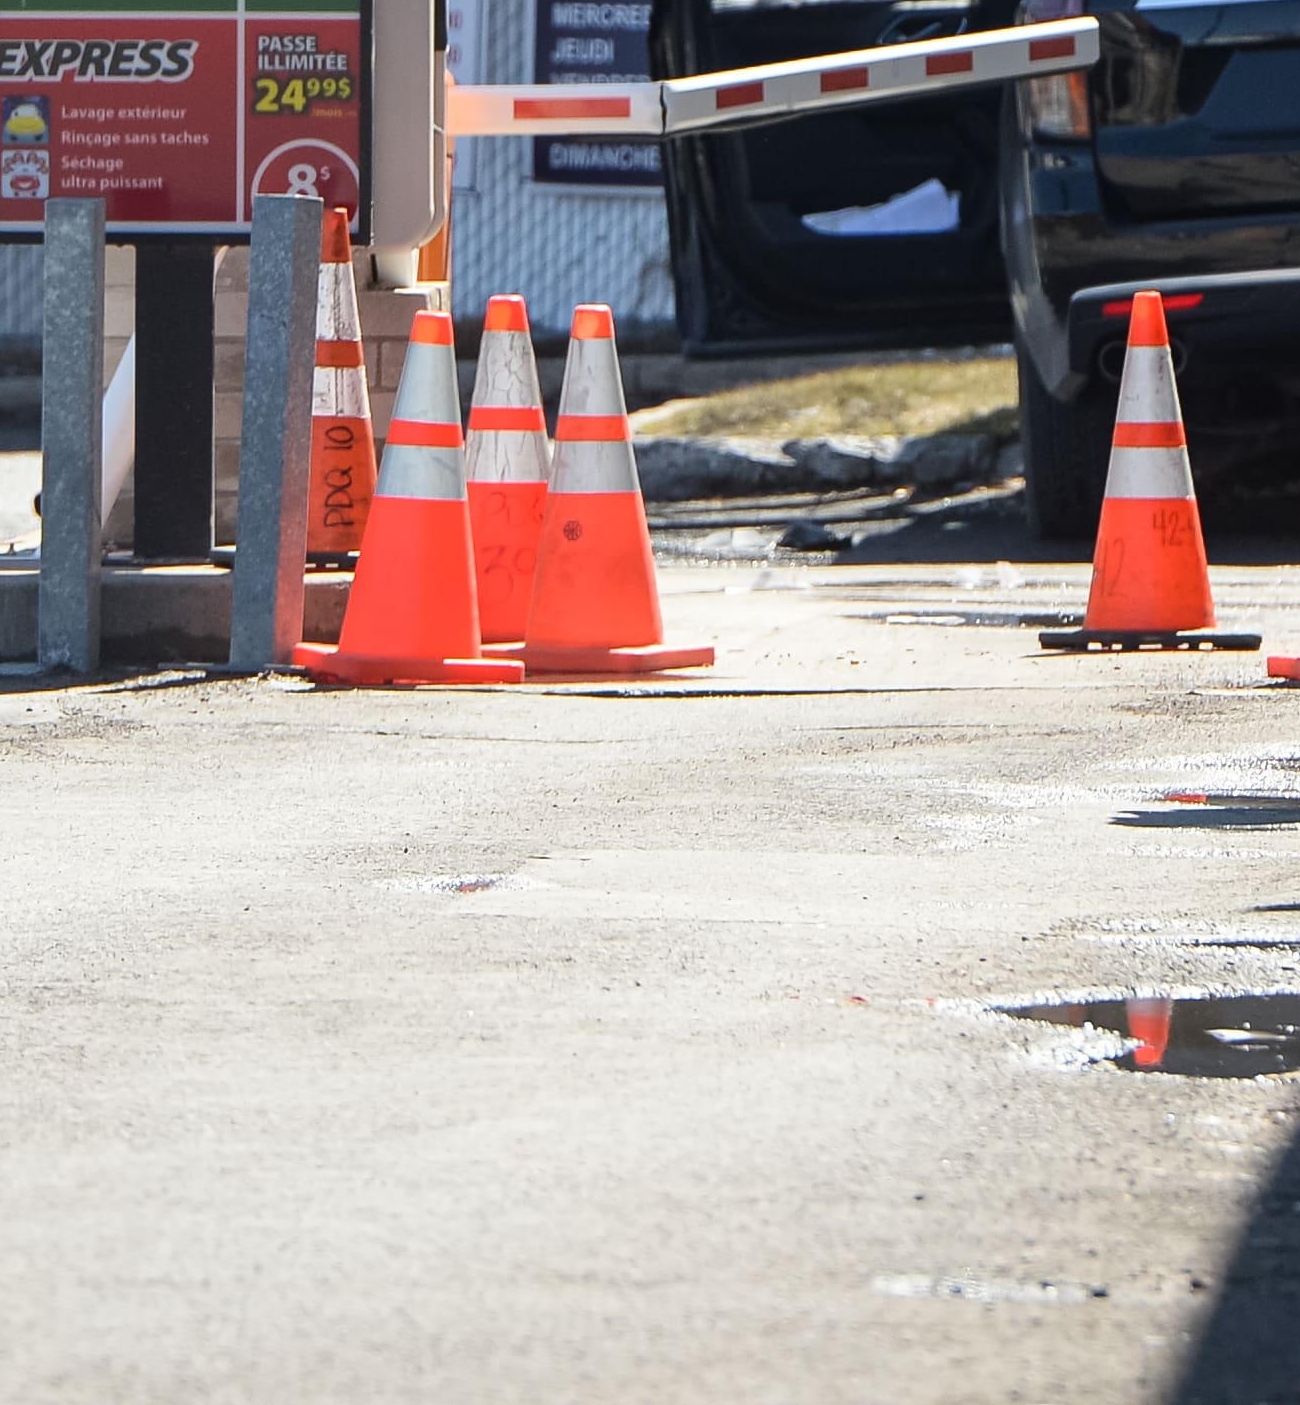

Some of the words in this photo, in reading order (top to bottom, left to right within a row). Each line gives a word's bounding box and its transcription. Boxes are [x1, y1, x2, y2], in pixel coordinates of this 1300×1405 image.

[258, 35, 317, 52] PASSE
[551, 38, 615, 64] JEUDI
[258, 51, 348, 71] ILLIMITÉE
[62, 105, 114, 122] Lavage
[118, 106, 186, 118] extérieur
[62, 130, 120, 146] Rinçage
[125, 134, 157, 144] sans
[161, 131, 208, 144] taches
[62, 156, 123, 172] Séchage
[549, 143, 660, 171] DIMANCHE
[62, 175, 96, 188] ultra
[100, 175, 162, 191] puissant
[323, 466, 355, 528] PDQ
